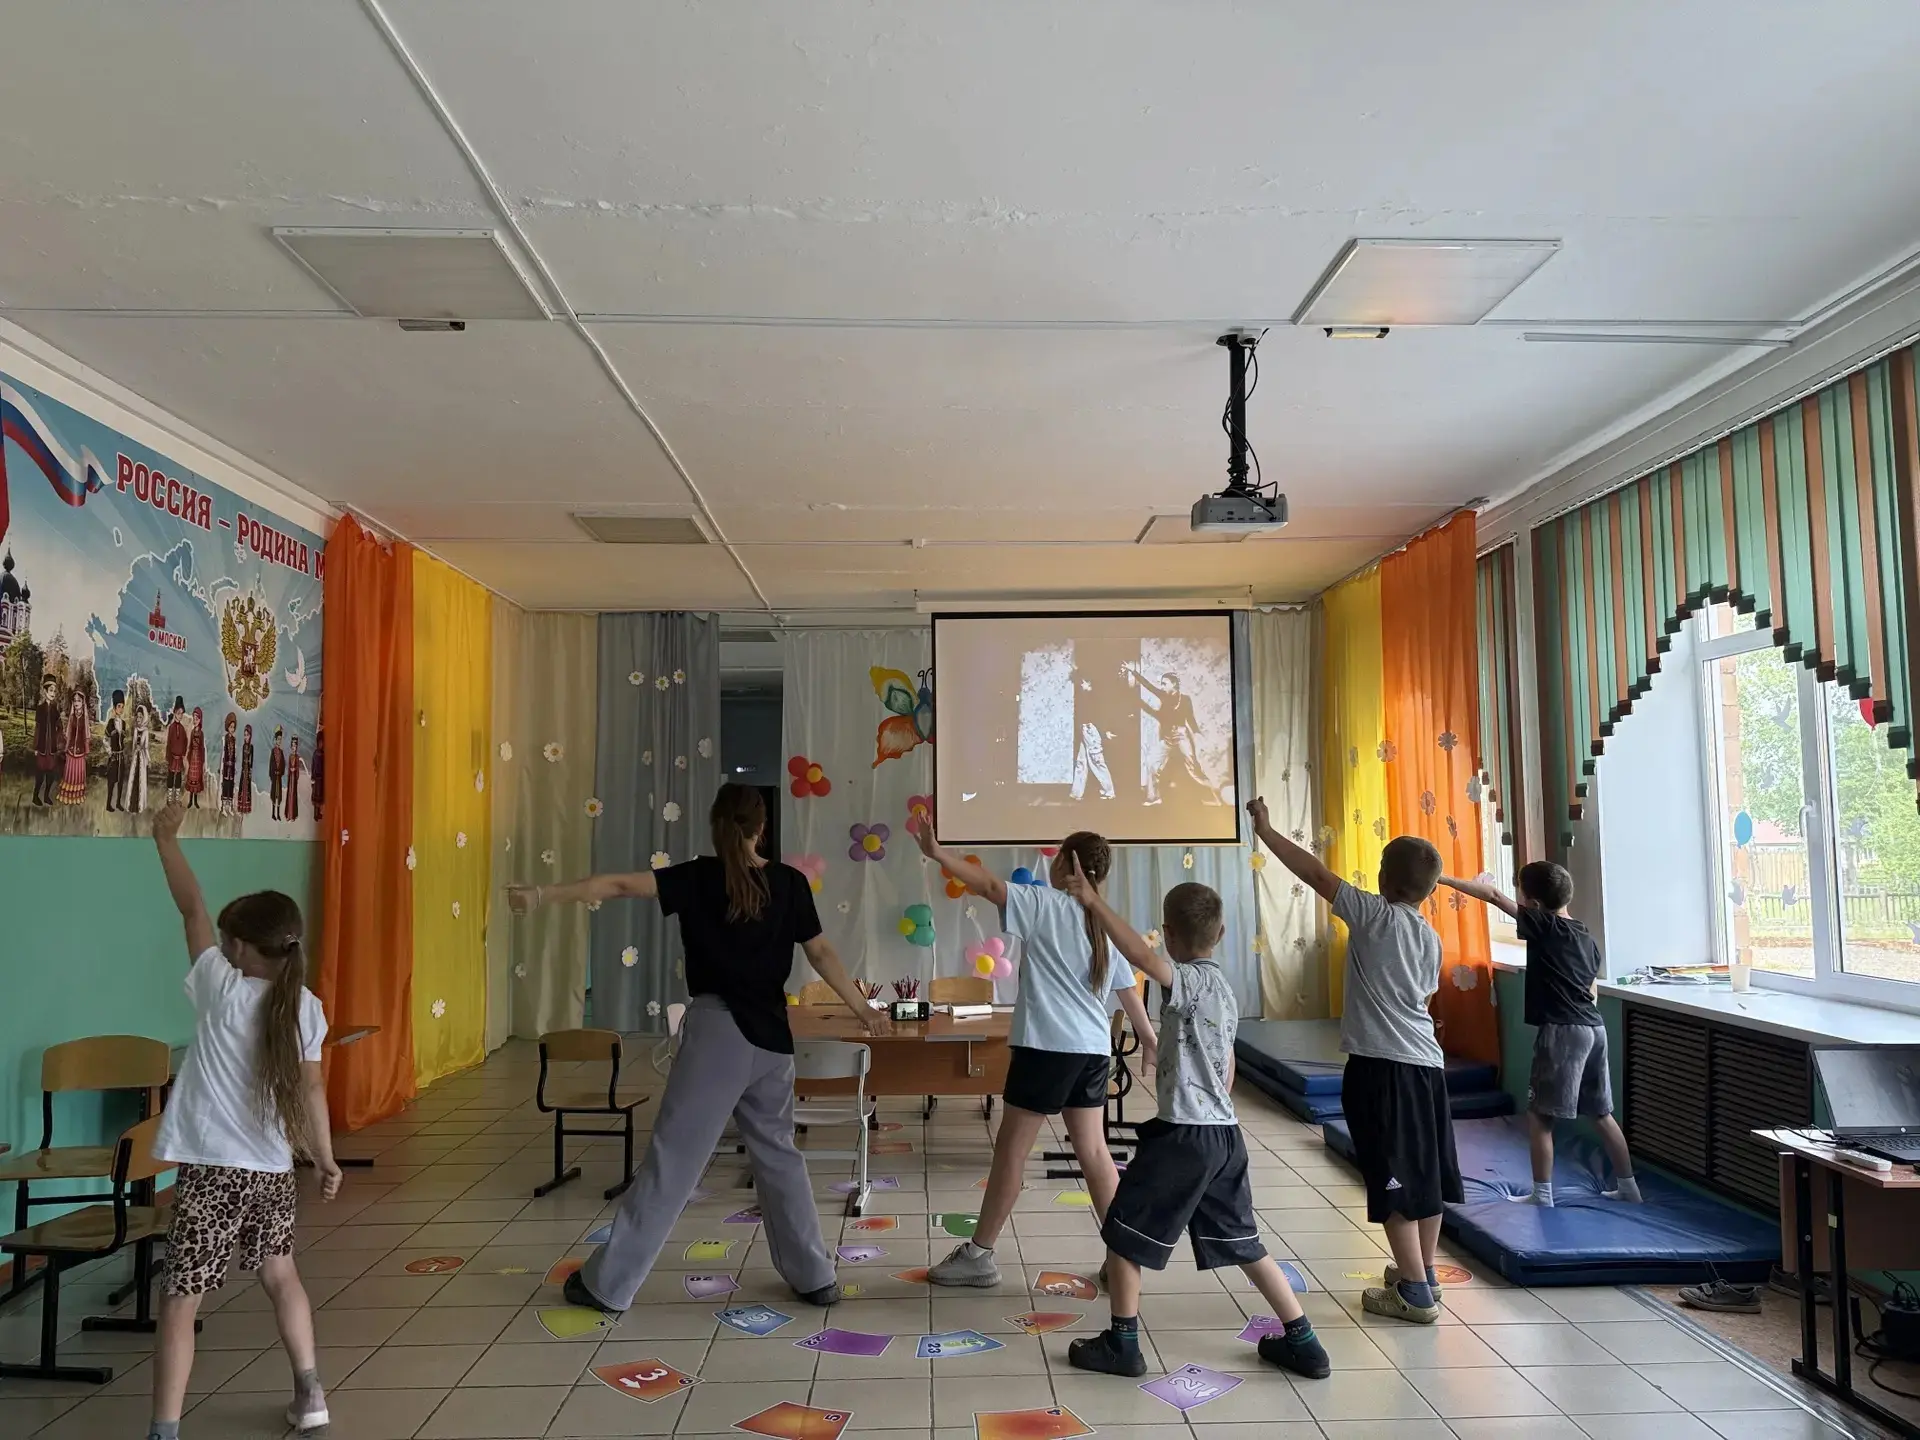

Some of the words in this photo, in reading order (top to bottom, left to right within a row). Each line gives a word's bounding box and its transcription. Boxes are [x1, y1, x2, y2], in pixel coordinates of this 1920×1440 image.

[116, 452, 213, 532] РОССИЯ
[237, 511, 309, 576] РОДИНА
[158, 629, 188, 653] МОСКВА
[802, 1334, 828, 1347] 22
[927, 1342, 942, 1354] 23
[635, 1368, 669, 1381] 3
[1167, 1376, 1207, 1392] 2
[823, 1413, 843, 1423] 5
